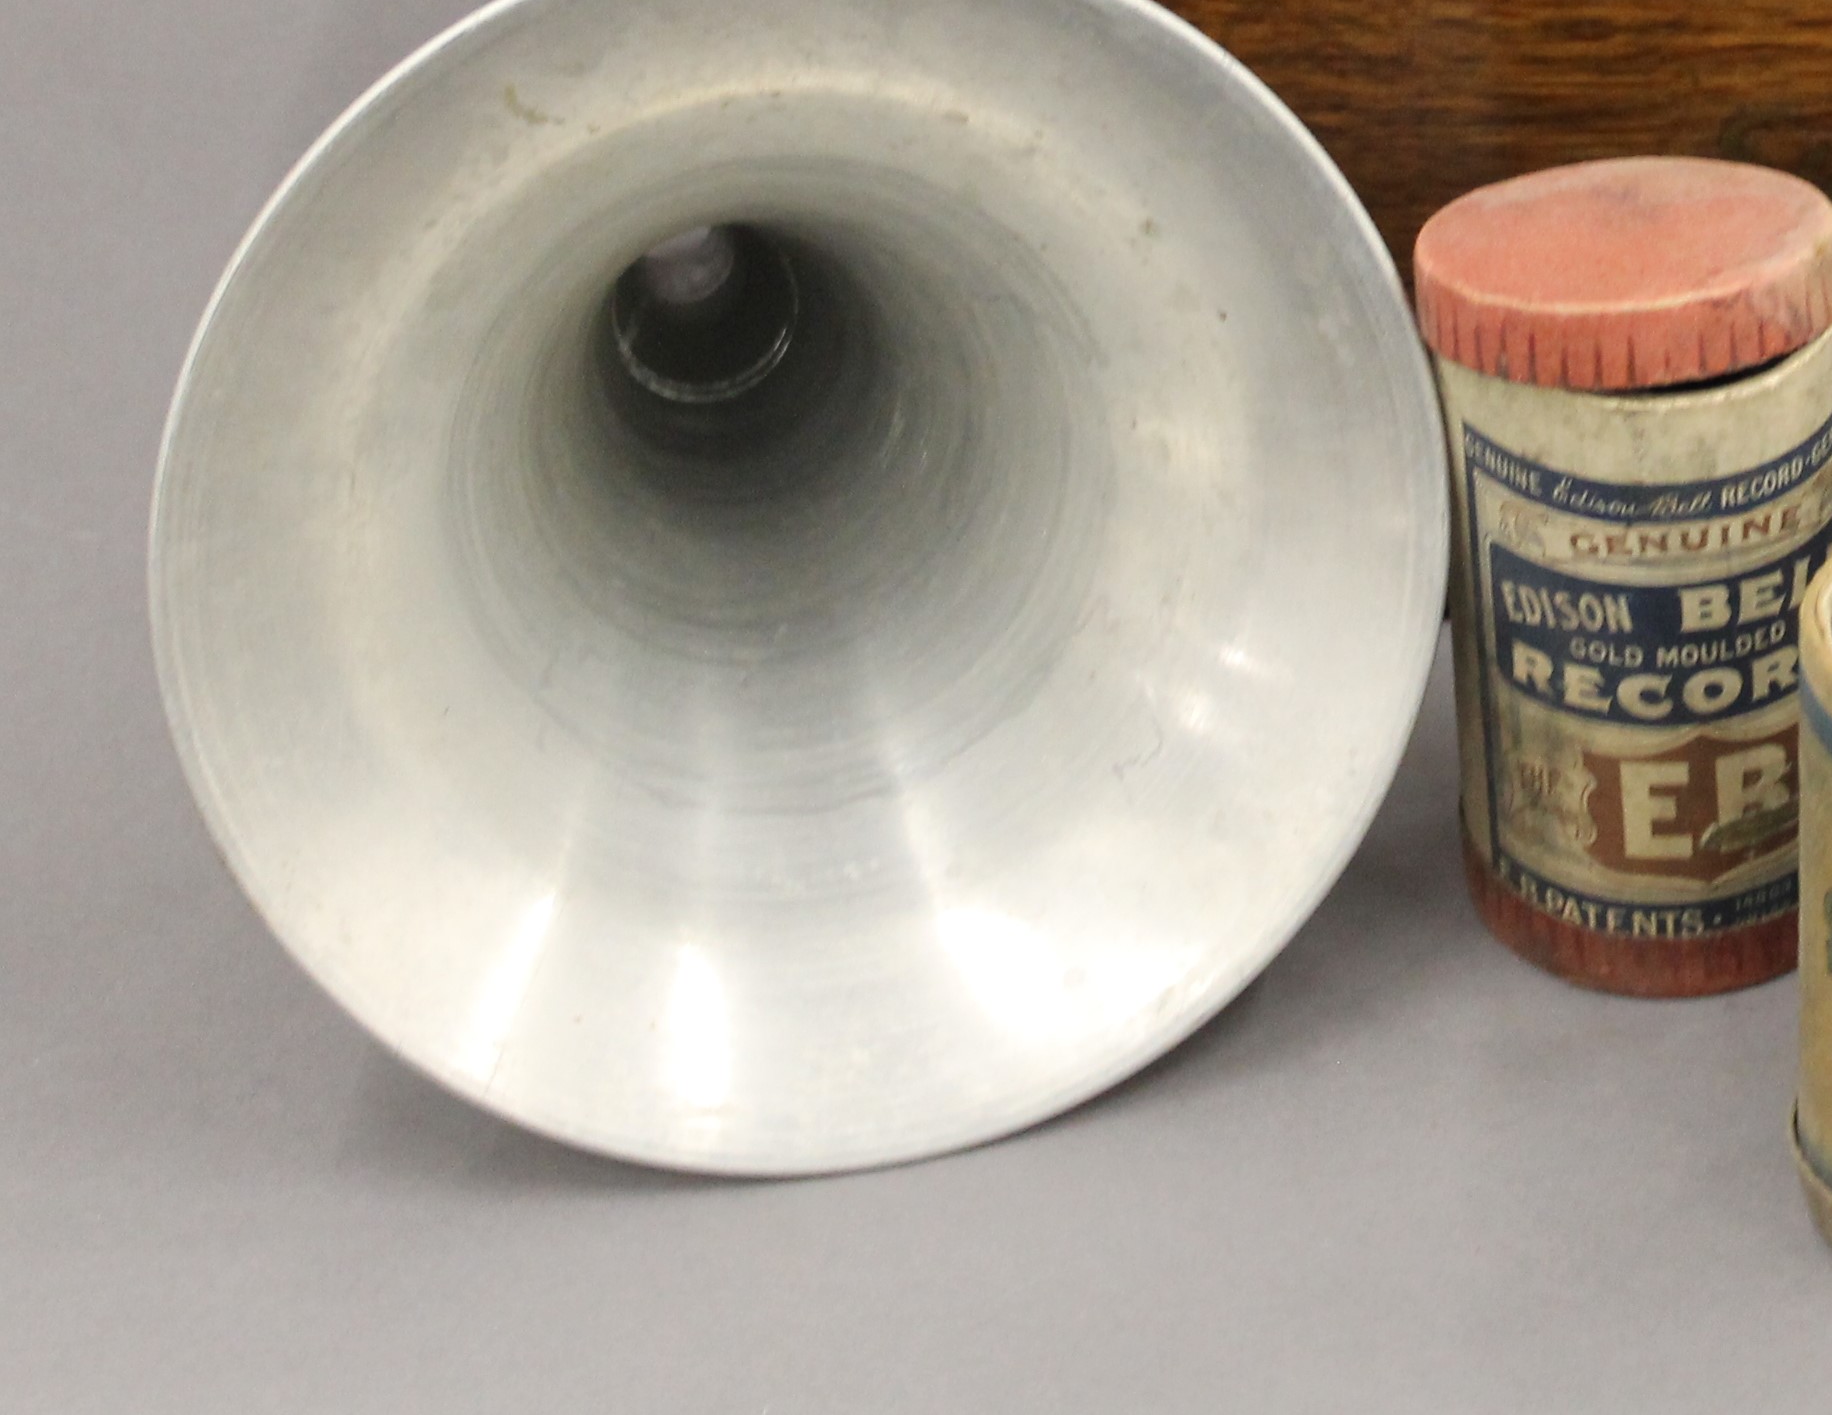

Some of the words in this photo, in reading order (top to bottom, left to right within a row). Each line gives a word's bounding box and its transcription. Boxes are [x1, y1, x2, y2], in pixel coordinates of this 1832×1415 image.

[1720, 455, 1804, 508] RECORD
[1569, 505, 1801, 557] GENUINE
[1501, 580, 1633, 634] EDISON
[1569, 637, 1644, 668] GOLD
[1655, 619, 1786, 669] MOULDED
